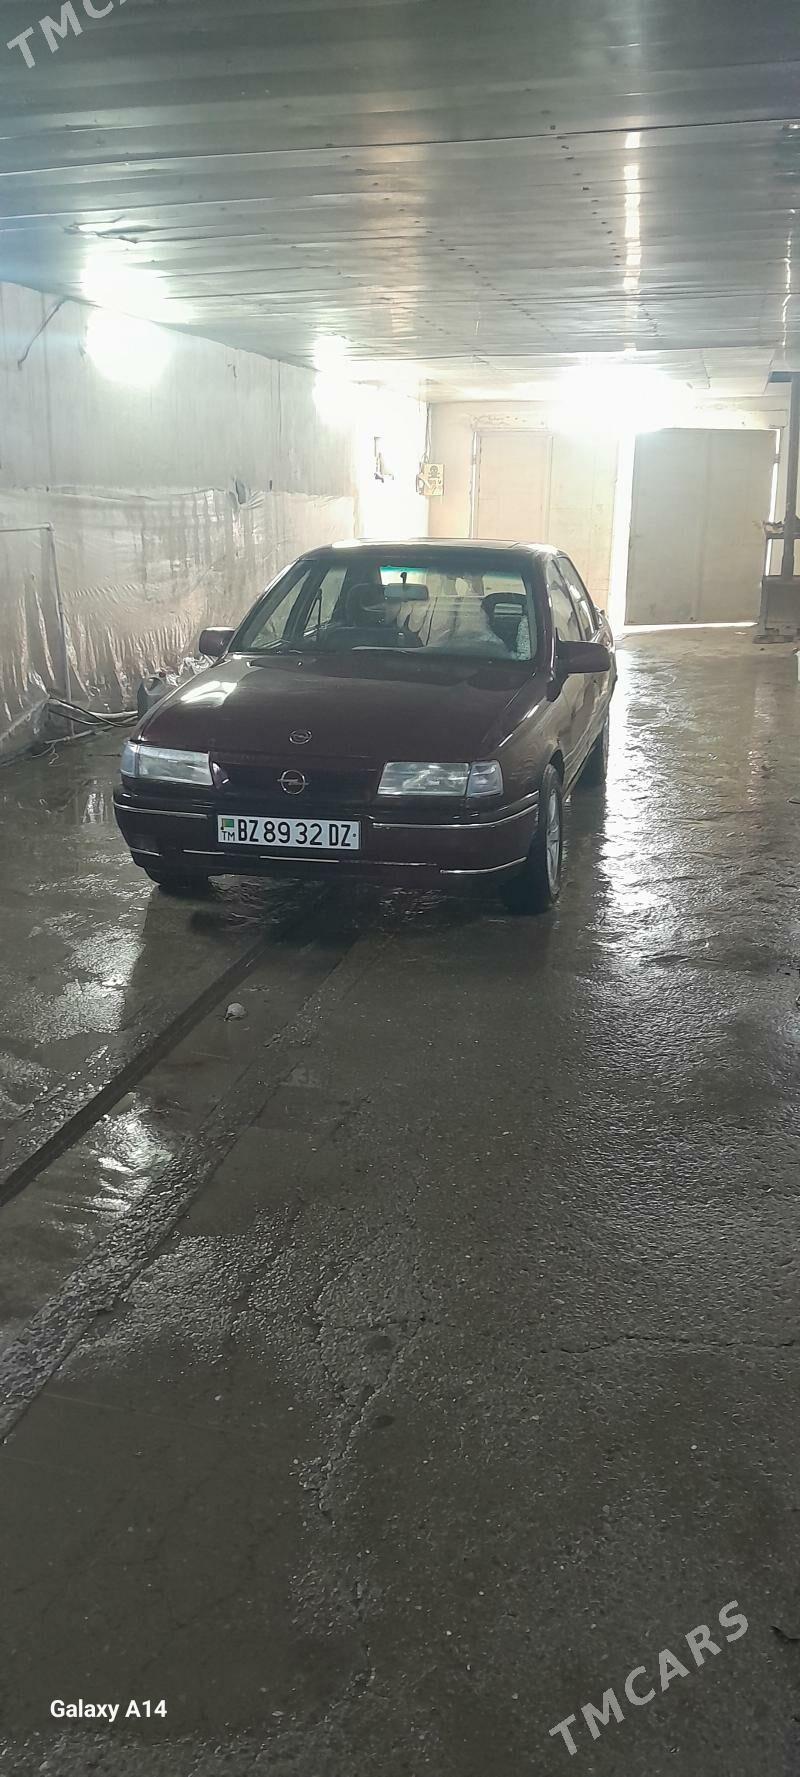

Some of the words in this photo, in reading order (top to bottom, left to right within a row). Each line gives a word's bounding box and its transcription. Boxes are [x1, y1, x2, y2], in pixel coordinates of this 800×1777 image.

[222, 831, 235, 841] TM
[238, 819, 259, 842] BZ
[329, 824, 351, 846] DZ
